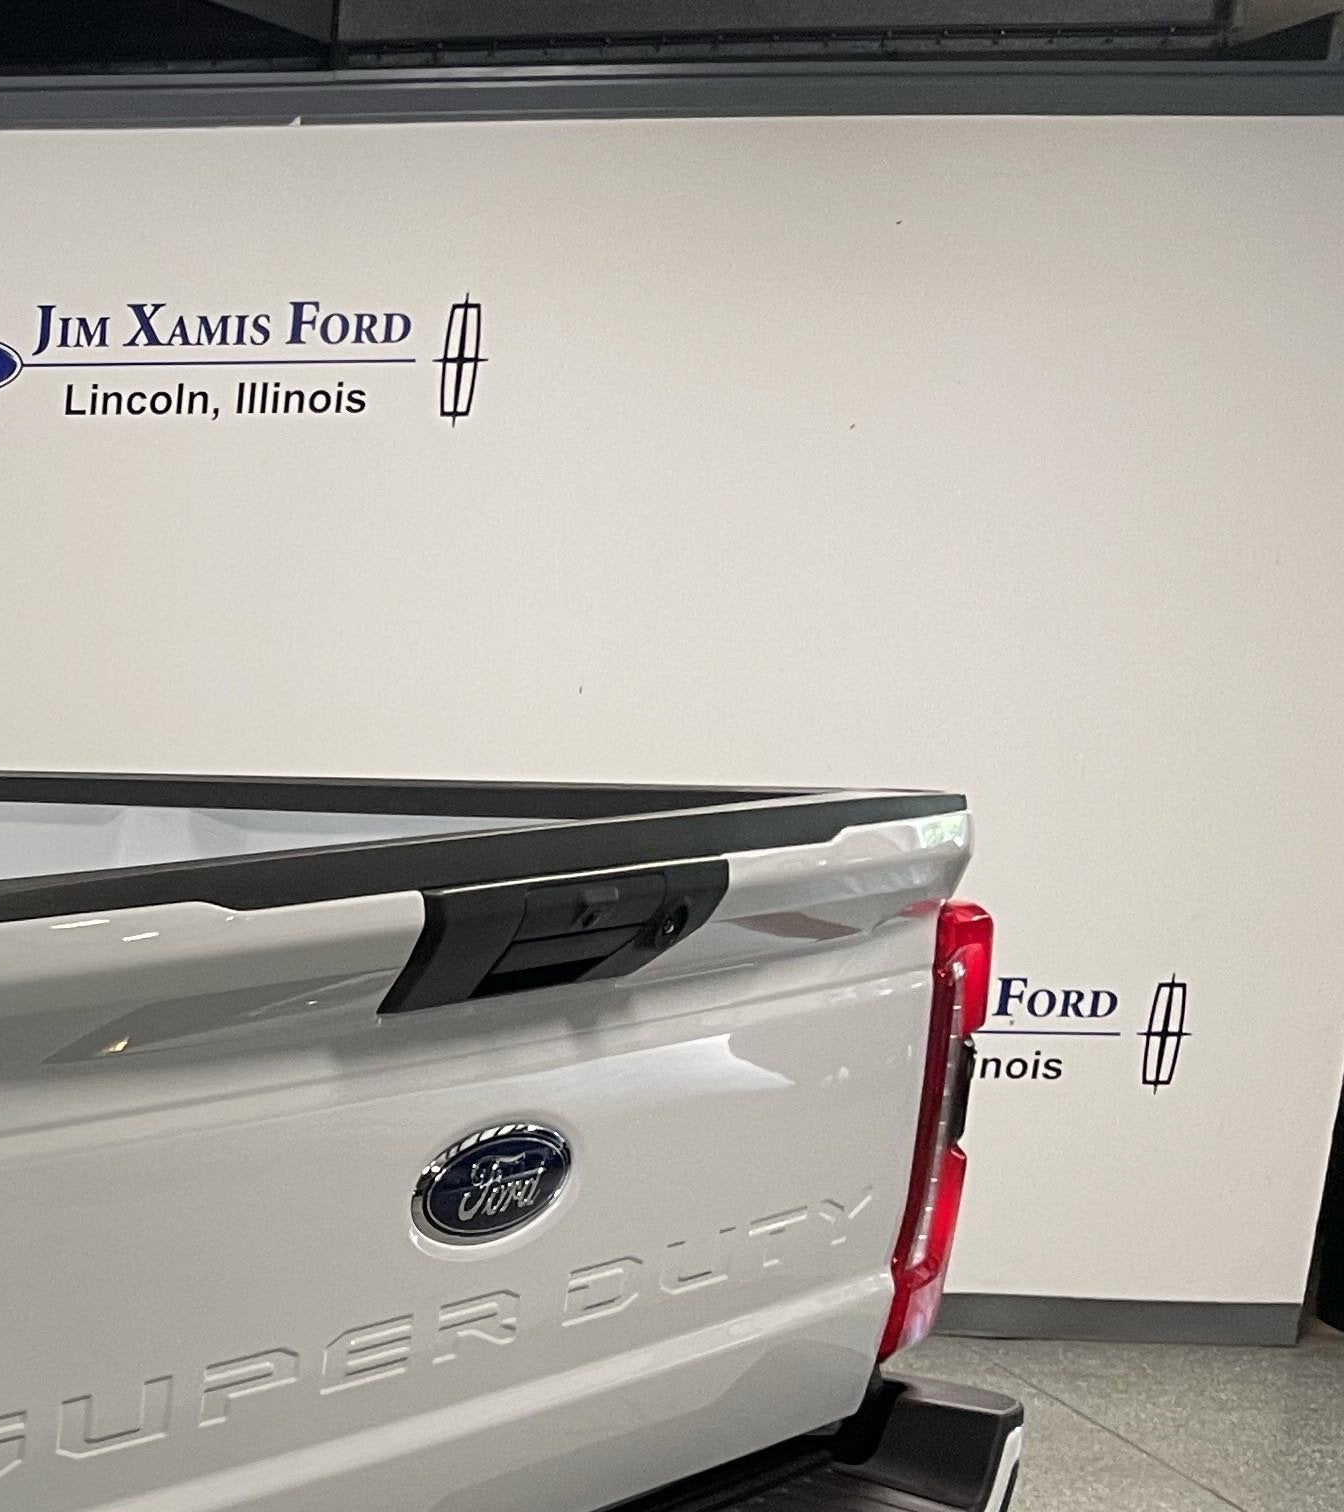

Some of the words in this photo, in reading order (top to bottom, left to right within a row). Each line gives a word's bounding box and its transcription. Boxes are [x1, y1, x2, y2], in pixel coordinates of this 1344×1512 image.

[64, 382, 221, 421] Lincoln,
[235, 382, 368, 415] Illinois
[980, 1050, 1062, 1081] nois
[561, 1184, 874, 1328] DUTY
